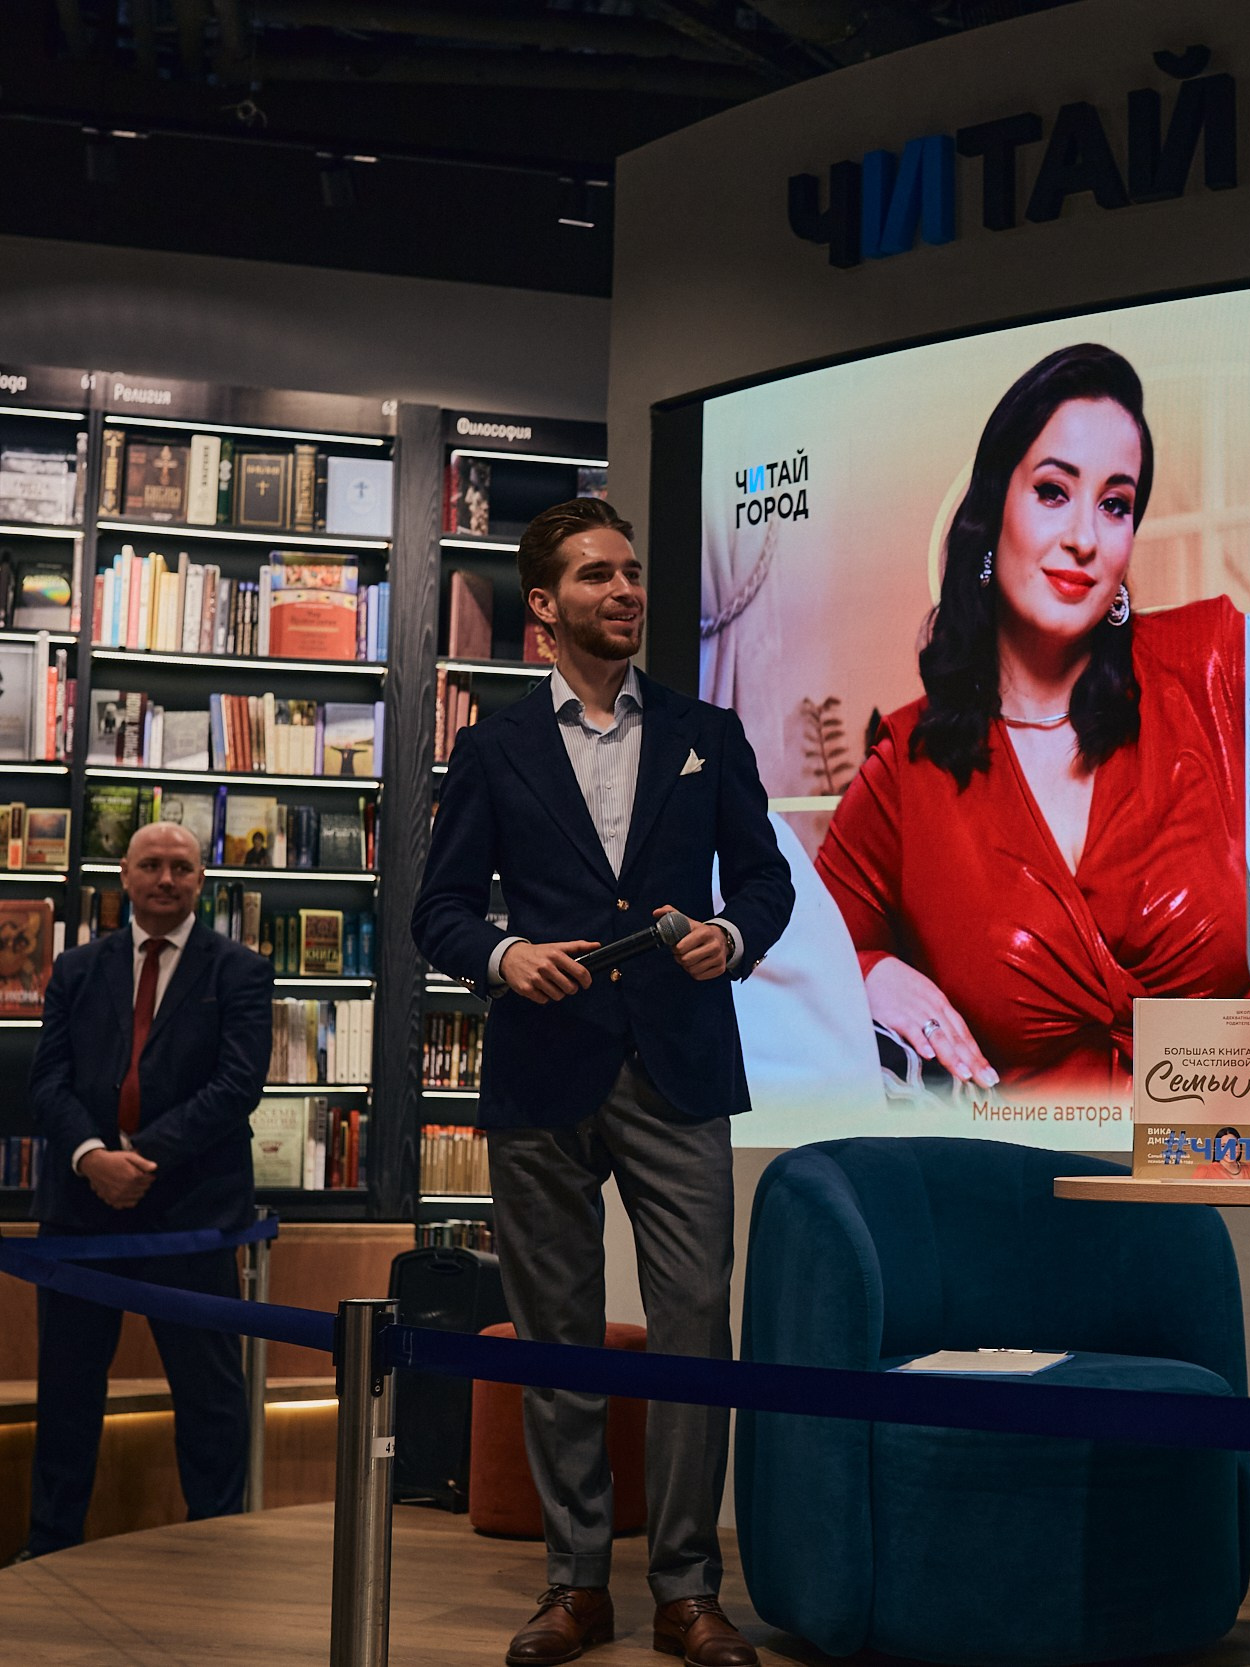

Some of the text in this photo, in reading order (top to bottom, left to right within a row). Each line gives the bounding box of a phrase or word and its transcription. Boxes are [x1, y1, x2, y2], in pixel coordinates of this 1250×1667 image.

[787, 44, 1238, 268] ЧИТАЙ
[0, 375, 28, 394] ода
[113, 382, 172, 406] Религия
[456, 416, 533, 442] Философия
[735, 447, 809, 495] ЧИТАЙ
[735, 488, 809, 530] ГОРОД
[1164, 1047, 1216, 1056] БОЛЬШАЯ
[972, 1100, 1048, 1121] Мнение
[1053, 1105, 1123, 1128] автора
[1147, 1127, 1172, 1135] ВИКА
